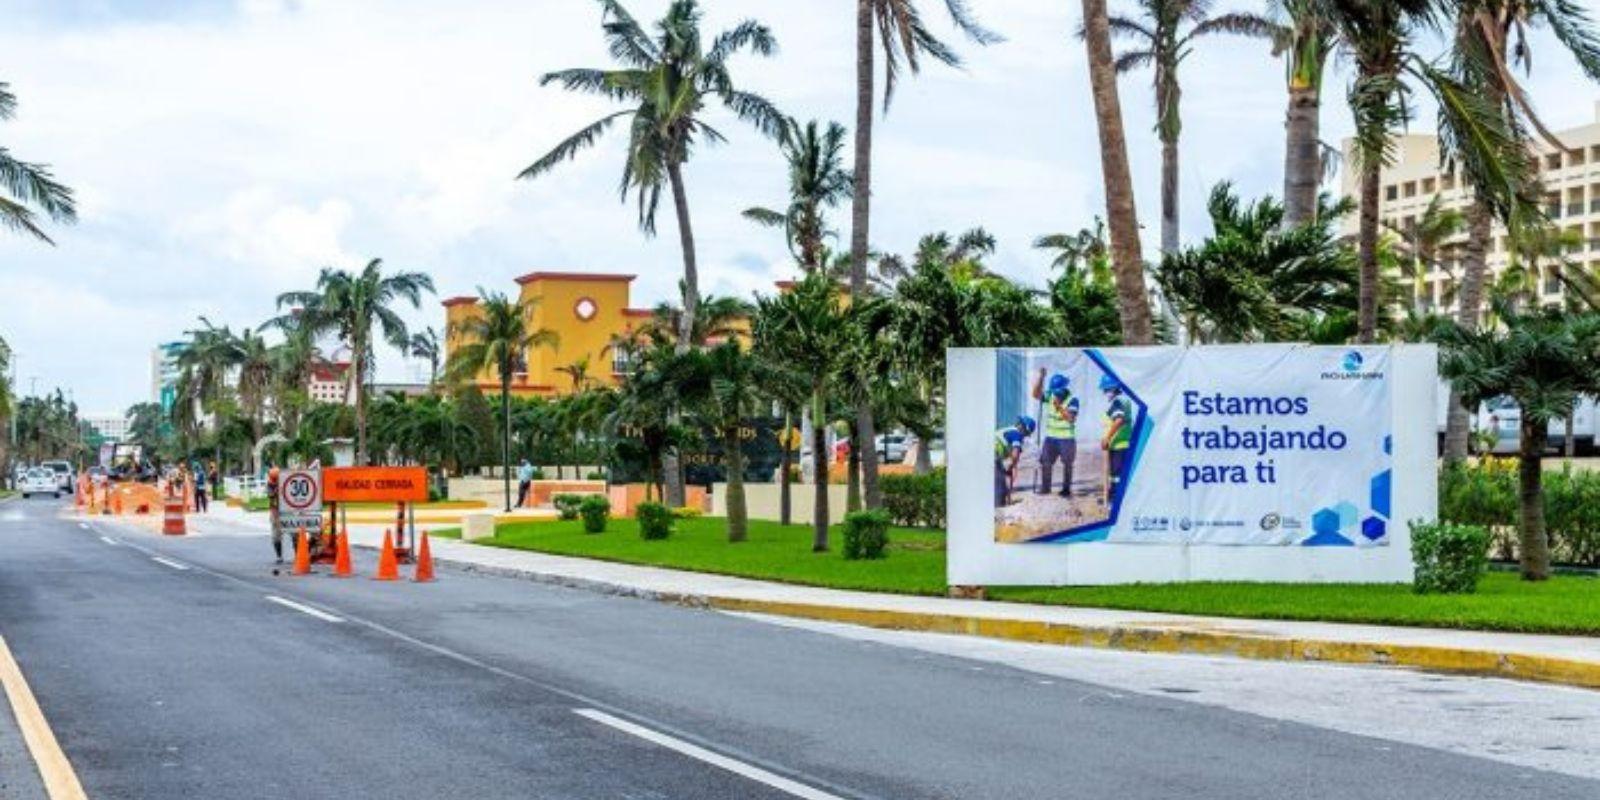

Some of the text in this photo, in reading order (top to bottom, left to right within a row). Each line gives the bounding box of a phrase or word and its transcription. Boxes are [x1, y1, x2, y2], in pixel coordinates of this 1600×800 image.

[1182, 390, 1309, 415] Estamos
[1182, 425, 1348, 456] trabajando
[374, 479, 414, 490] CERRADA
[1181, 459, 1276, 490] para ti
[289, 480, 309, 497] 30
